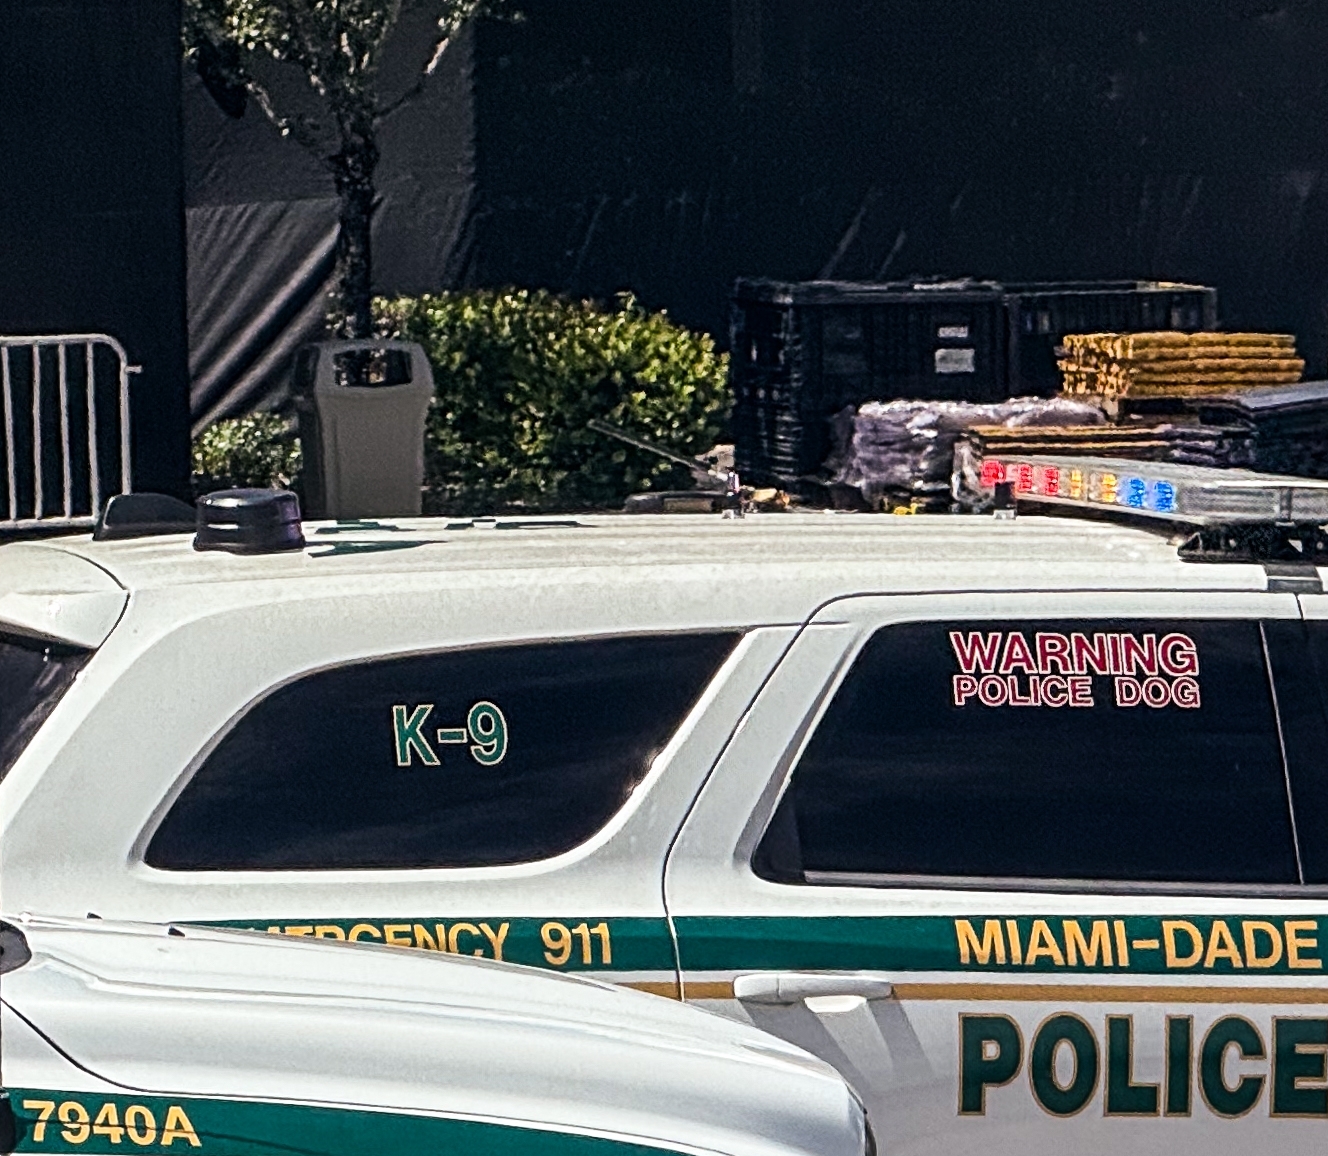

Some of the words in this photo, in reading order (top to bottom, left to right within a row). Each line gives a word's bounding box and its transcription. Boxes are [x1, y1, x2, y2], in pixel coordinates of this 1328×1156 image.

[950, 631, 1199, 676] WARNING
[953, 676, 1094, 706] POLICE
[1115, 677, 1201, 708] DOG
[392, 700, 508, 767] K-9
[540, 921, 612, 965] 911
[955, 919, 1323, 969] MIAMI-DADE
[22, 1098, 203, 1148] 7940A
